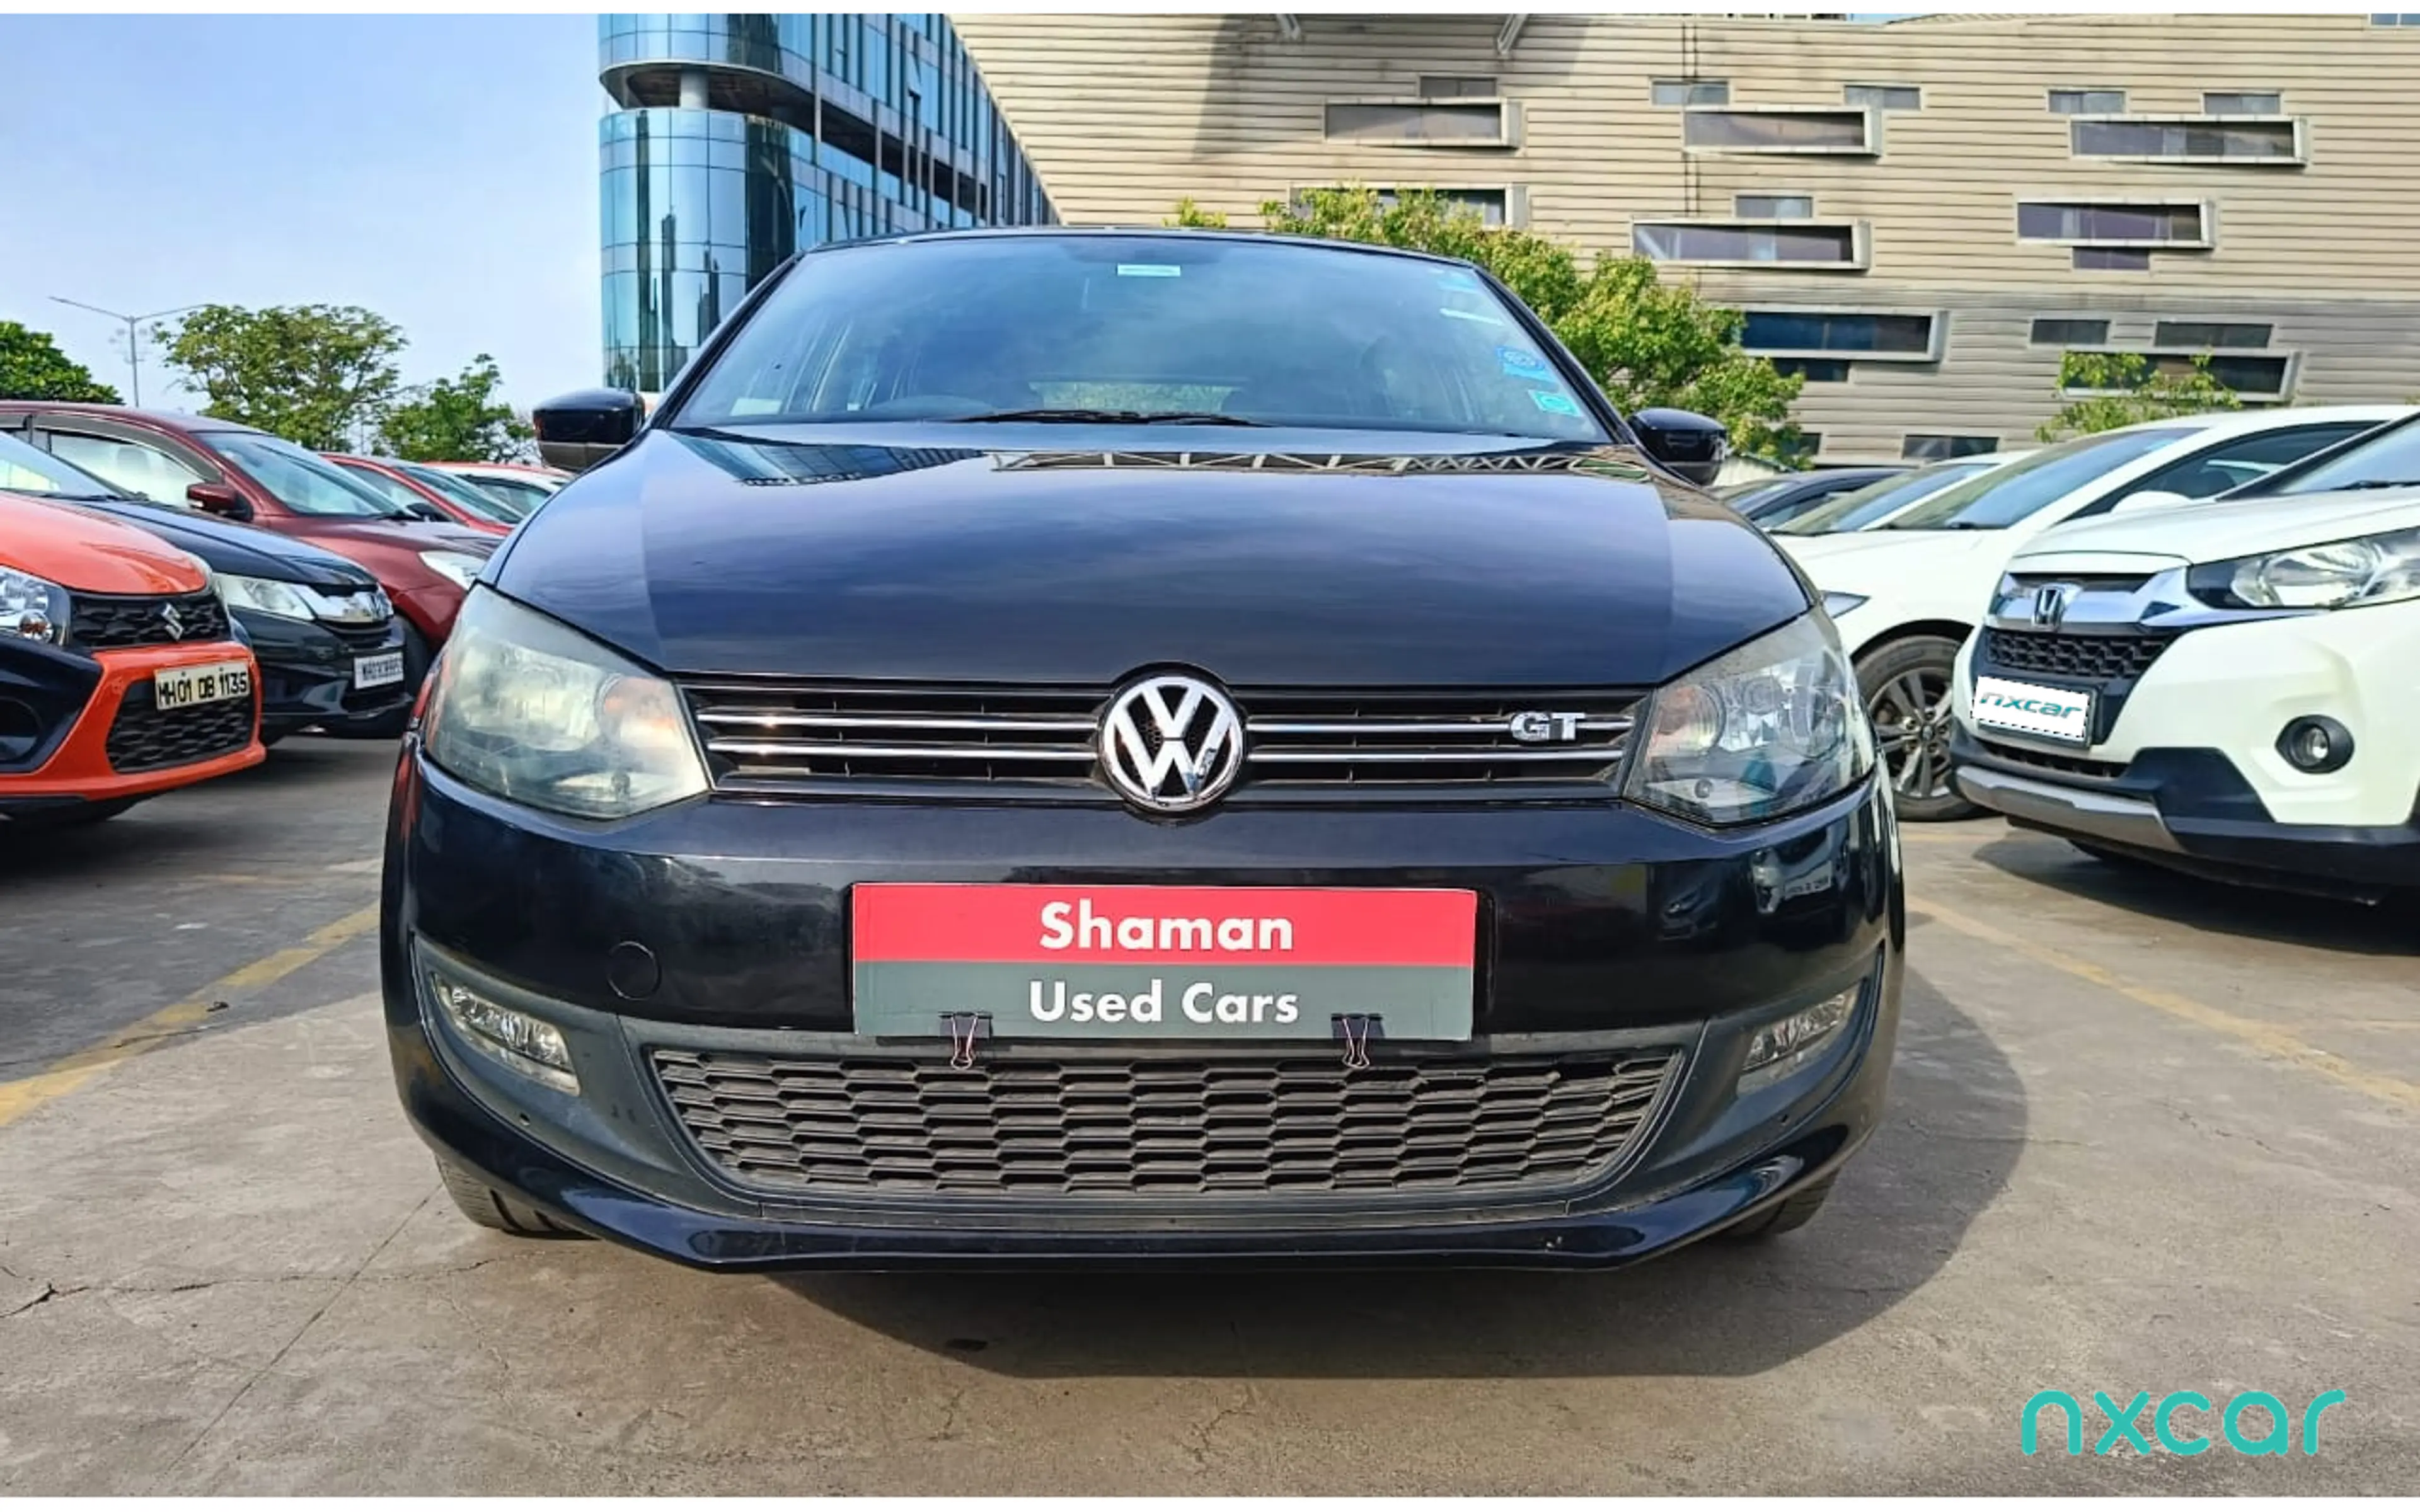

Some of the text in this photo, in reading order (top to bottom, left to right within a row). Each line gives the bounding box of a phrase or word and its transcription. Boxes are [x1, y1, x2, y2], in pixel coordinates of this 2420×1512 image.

[219, 671, 247, 696] 1135
[1511, 711, 1586, 742] GT
[1039, 898, 1293, 951] Shaman
[1029, 980, 1299, 1024] Used Cars
